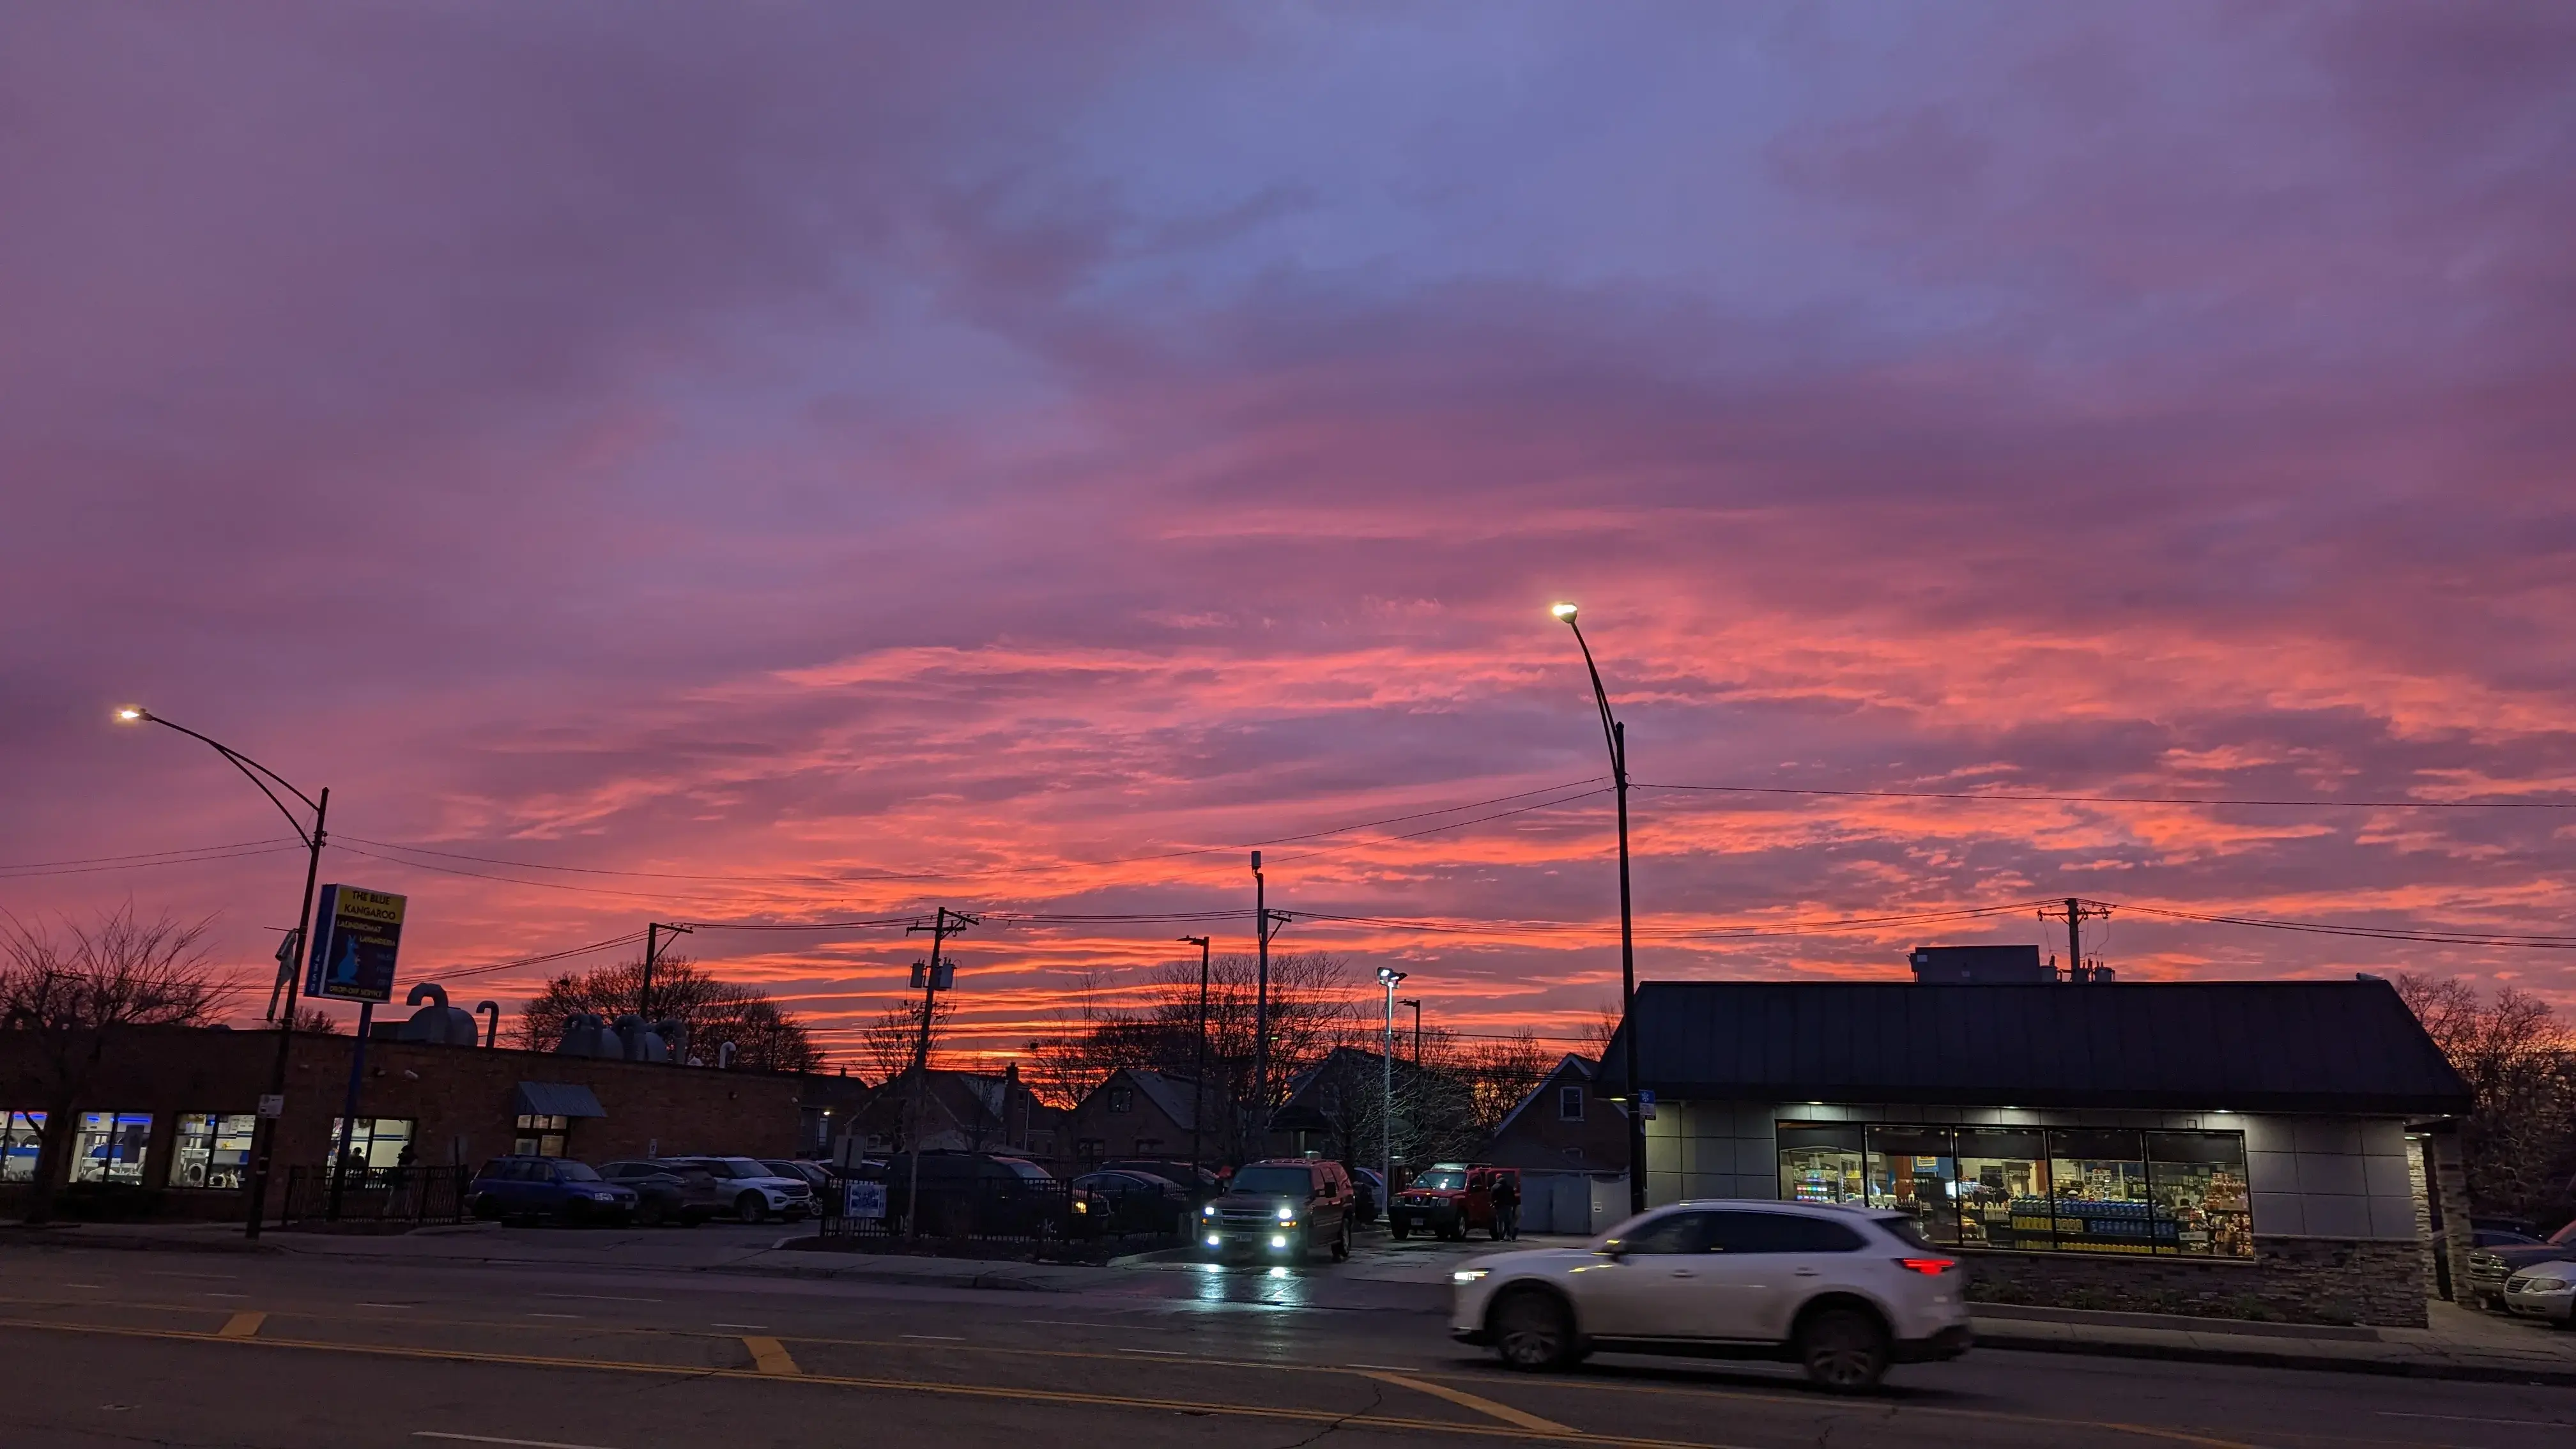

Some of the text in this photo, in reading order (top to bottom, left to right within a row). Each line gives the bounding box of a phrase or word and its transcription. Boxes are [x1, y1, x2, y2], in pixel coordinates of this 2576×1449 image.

[353, 891, 390, 905] THE BLUE
[344, 903, 395, 920] KANGAROO
